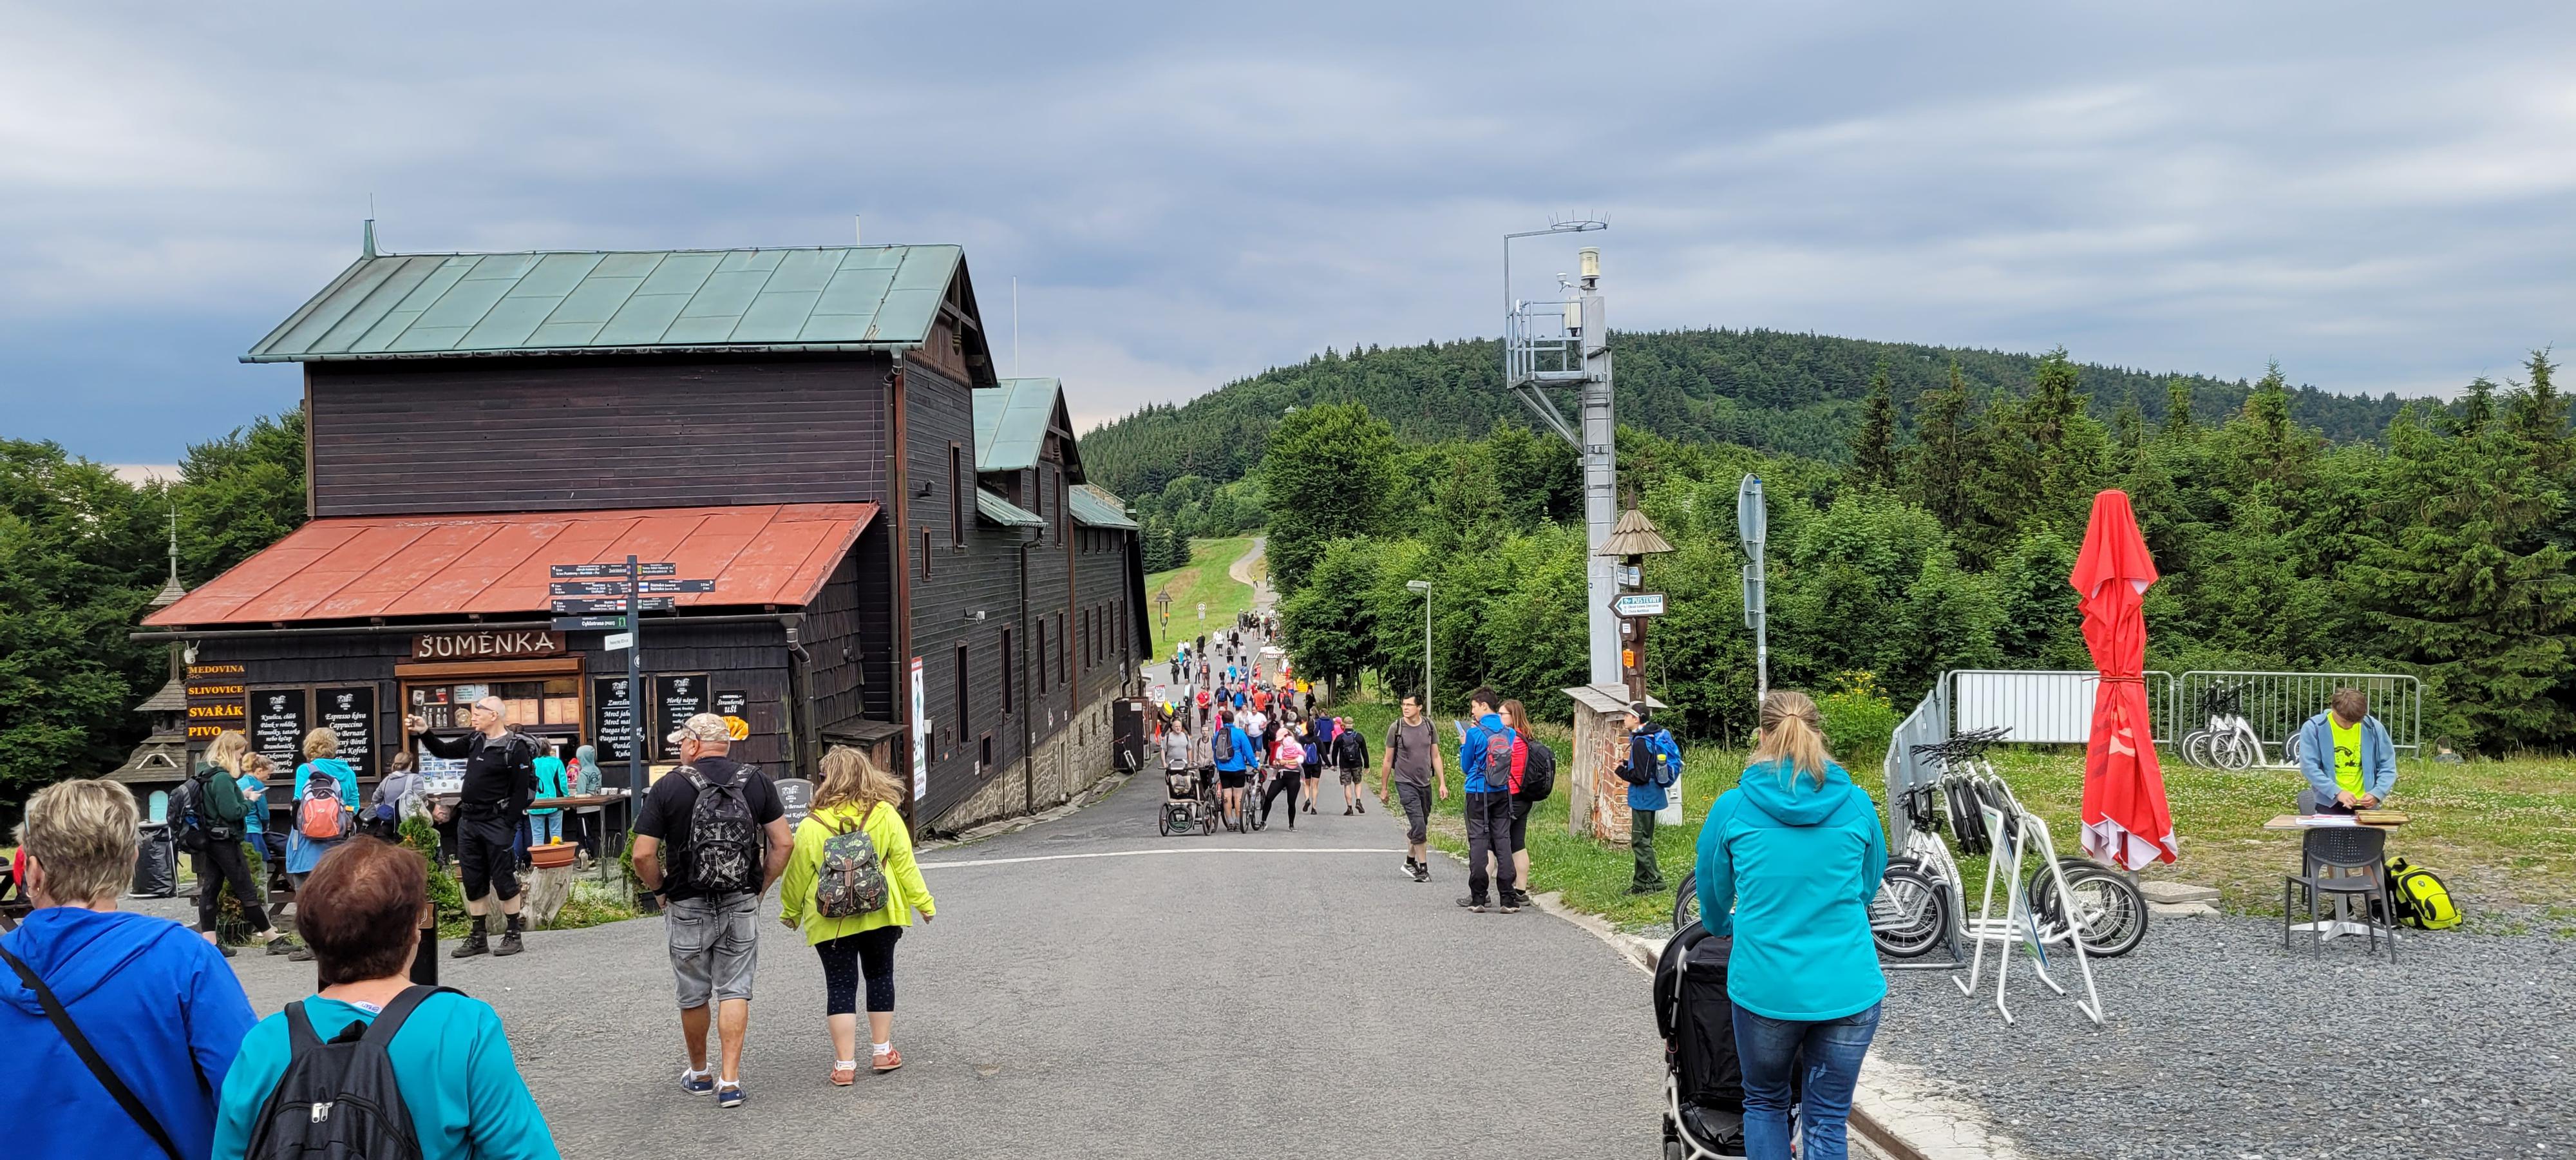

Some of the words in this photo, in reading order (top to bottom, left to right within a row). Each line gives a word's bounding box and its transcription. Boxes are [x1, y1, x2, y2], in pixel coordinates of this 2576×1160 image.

[419, 631, 555, 657] ŠUMĚNKA
[188, 685, 243, 694] SLIVOVICE
[189, 705, 243, 717] SVAŘÁK
[329, 721, 363, 730] Cappuccino
[188, 727, 222, 736] PIVO
